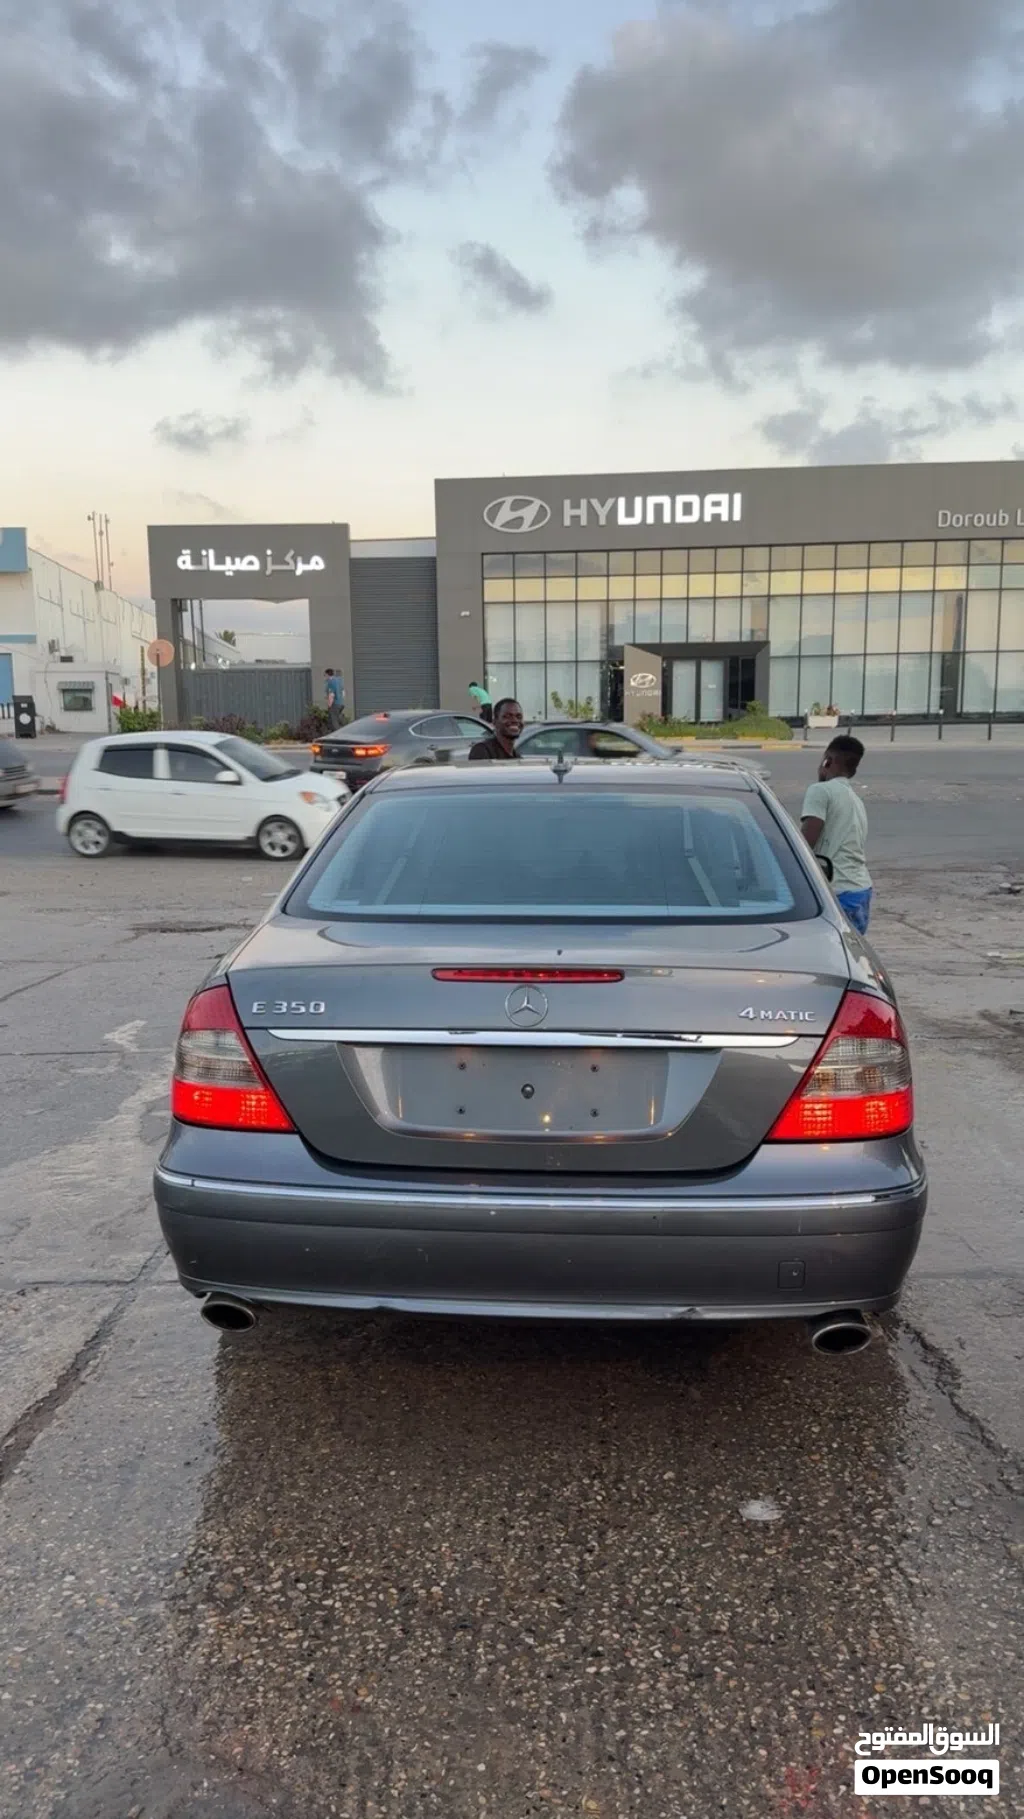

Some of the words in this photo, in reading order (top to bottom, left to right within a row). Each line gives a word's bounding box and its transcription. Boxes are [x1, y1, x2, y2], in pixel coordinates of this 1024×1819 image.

[563, 493, 742, 526] HYUNDAI
[938, 509, 1009, 528] Doroub
[177, 549, 260, 576] صيانة
[265, 549, 325, 576] مركز
[251, 1001, 266, 1014] E
[272, 1001, 326, 1014] 350
